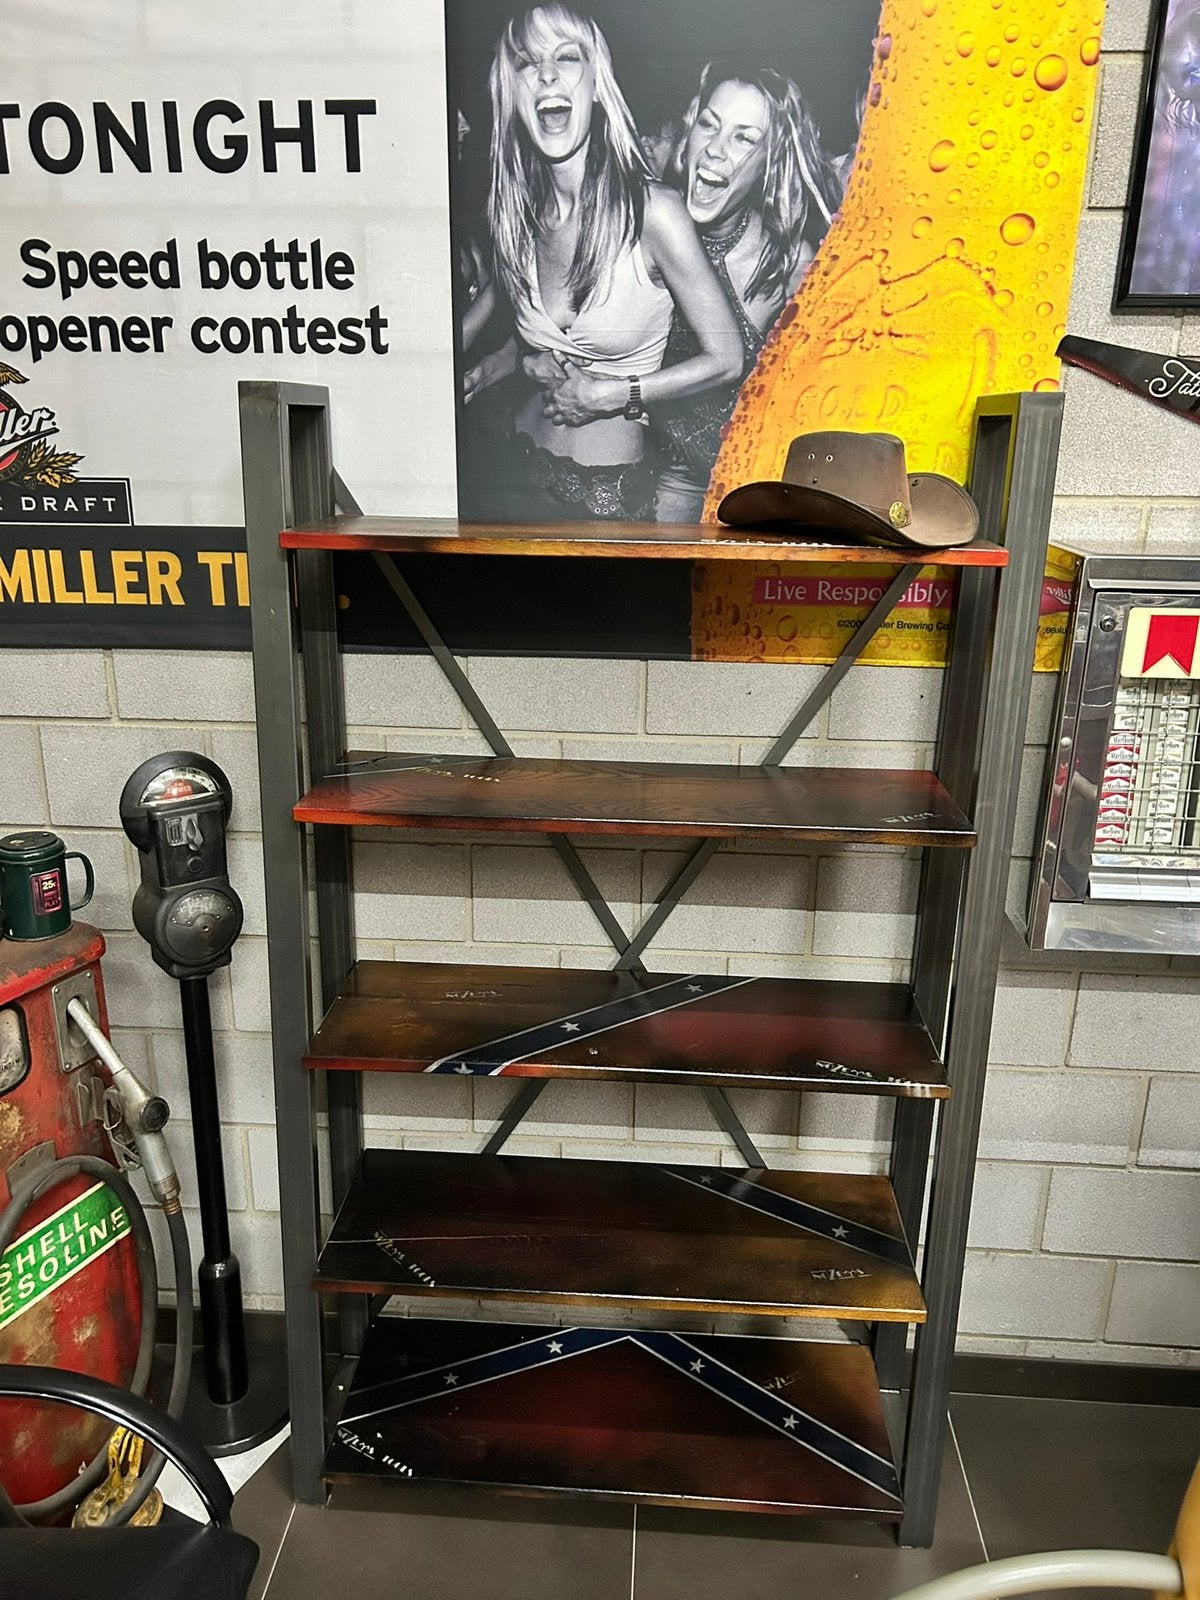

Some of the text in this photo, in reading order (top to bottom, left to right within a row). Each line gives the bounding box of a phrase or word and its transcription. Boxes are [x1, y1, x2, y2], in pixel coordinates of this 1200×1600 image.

[0, 98, 377, 174] TONIGHT
[20, 237, 355, 300] Speed bottle
[0, 304, 389, 363] opener contest
[21, 496, 116, 512] DRAFT
[0, 548, 250, 606] MILLER TI
[764, 580, 949, 606] Live Resposibly
[896, 620, 934, 632] Brewing
